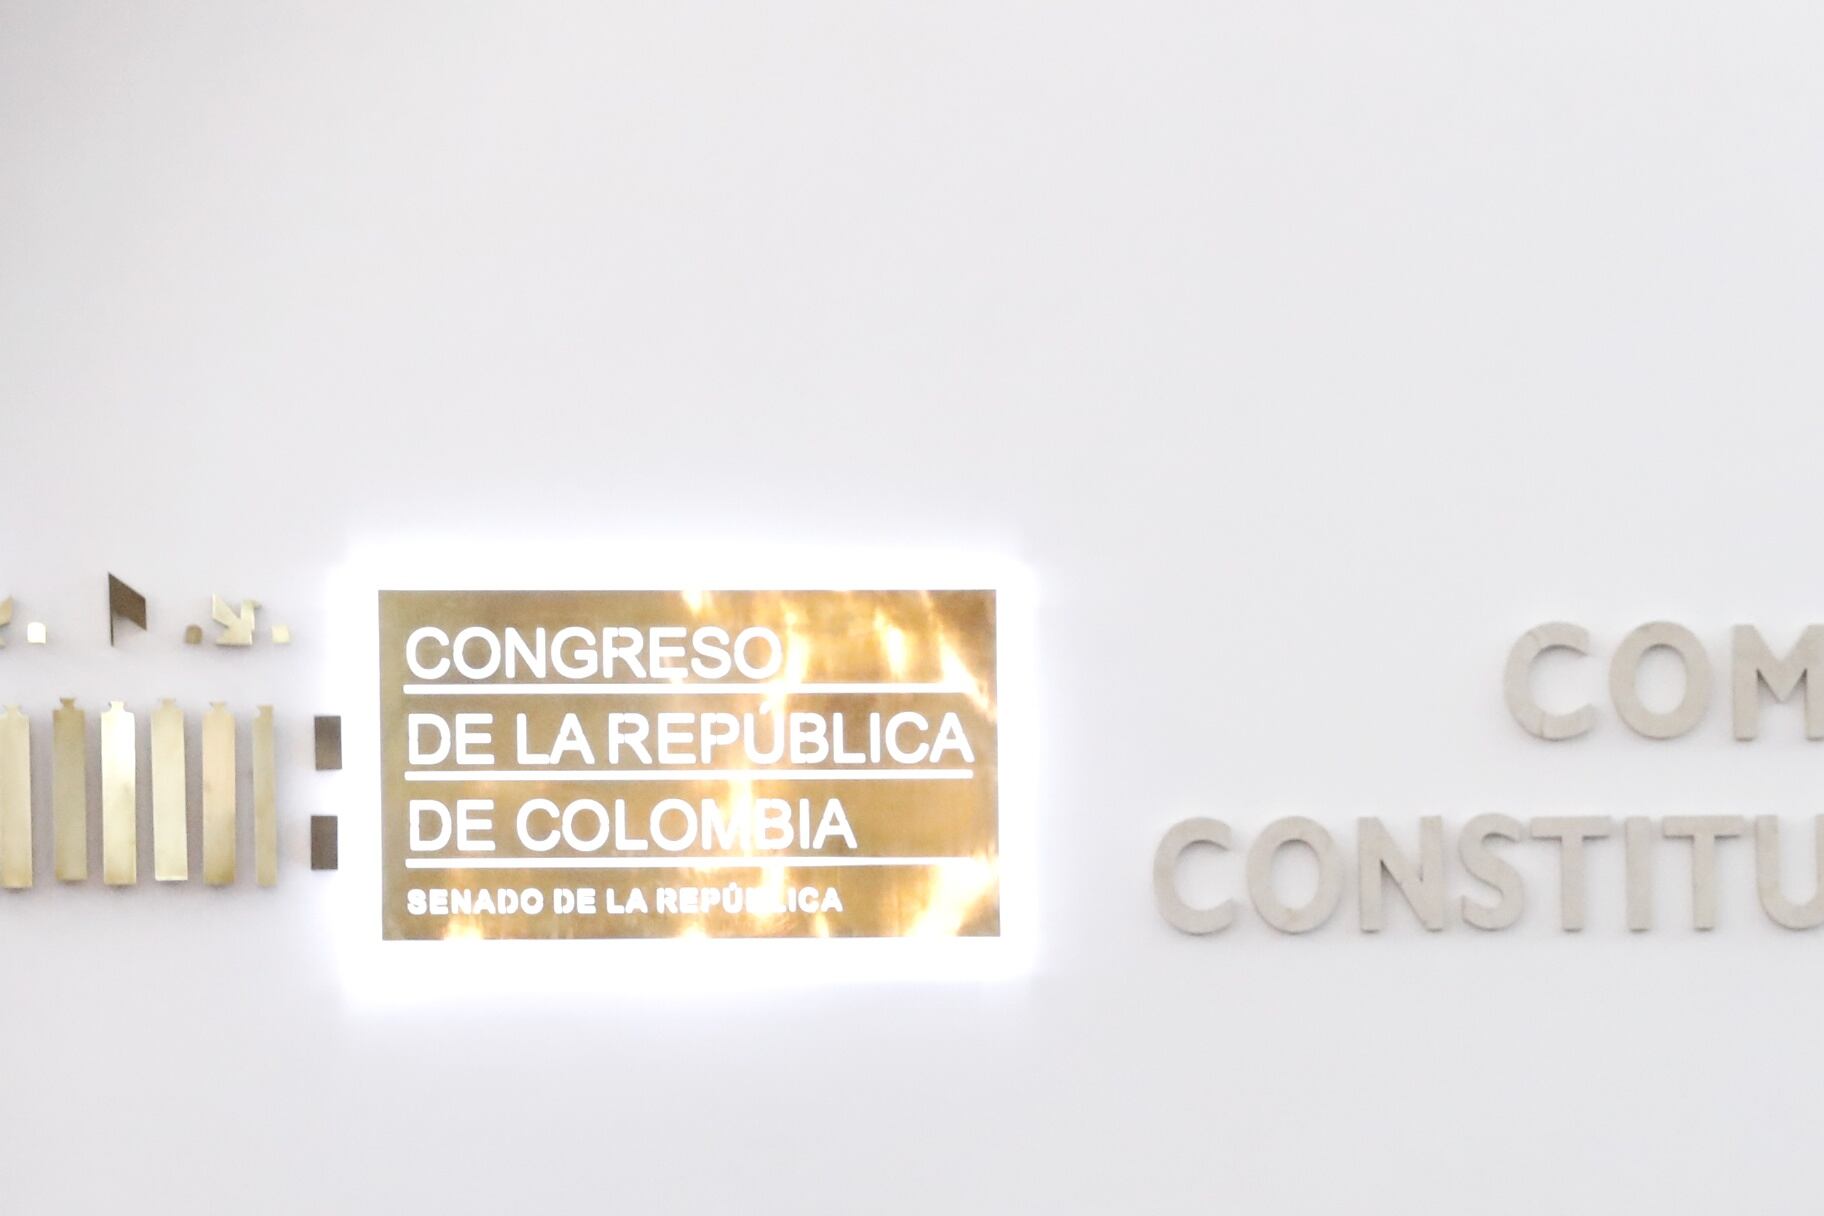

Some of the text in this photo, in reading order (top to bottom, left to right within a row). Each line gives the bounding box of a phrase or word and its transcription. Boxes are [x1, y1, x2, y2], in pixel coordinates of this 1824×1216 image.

[405, 626, 783, 680] CONGRESO
[407, 703, 975, 766] DE LA REPÚBLICA
[408, 797, 858, 852] DE COLOMBIA
[406, 886, 544, 915] SENADO
[553, 887, 597, 915] DE
[605, 886, 649, 914] LA
